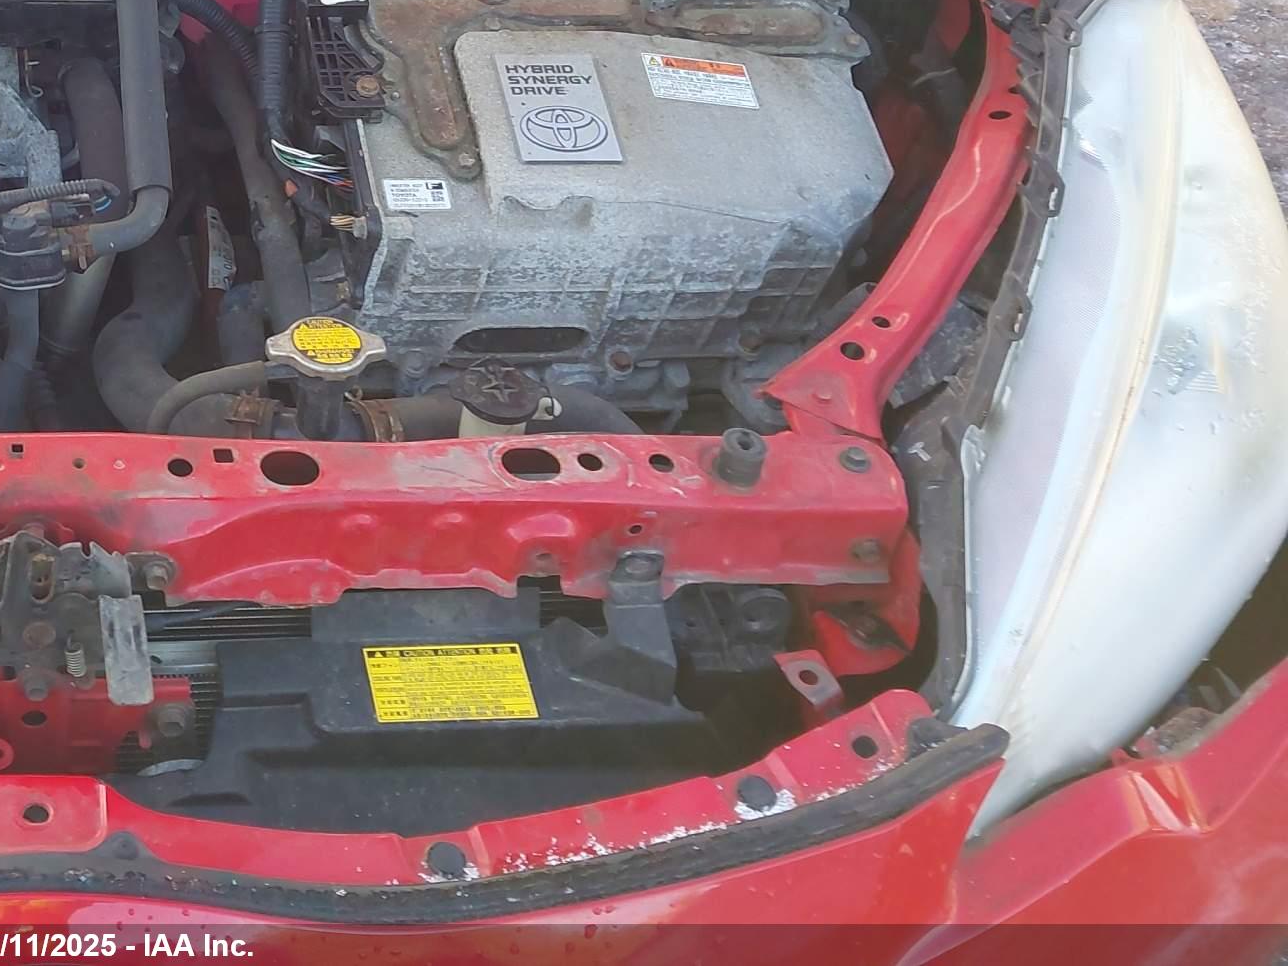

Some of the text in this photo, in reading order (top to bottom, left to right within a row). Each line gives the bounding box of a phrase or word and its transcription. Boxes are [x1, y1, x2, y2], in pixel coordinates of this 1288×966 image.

[505, 65, 573, 74] HYBRID
[507, 75, 592, 84] SYNERGY
[511, 86, 568, 95] DRIVE
